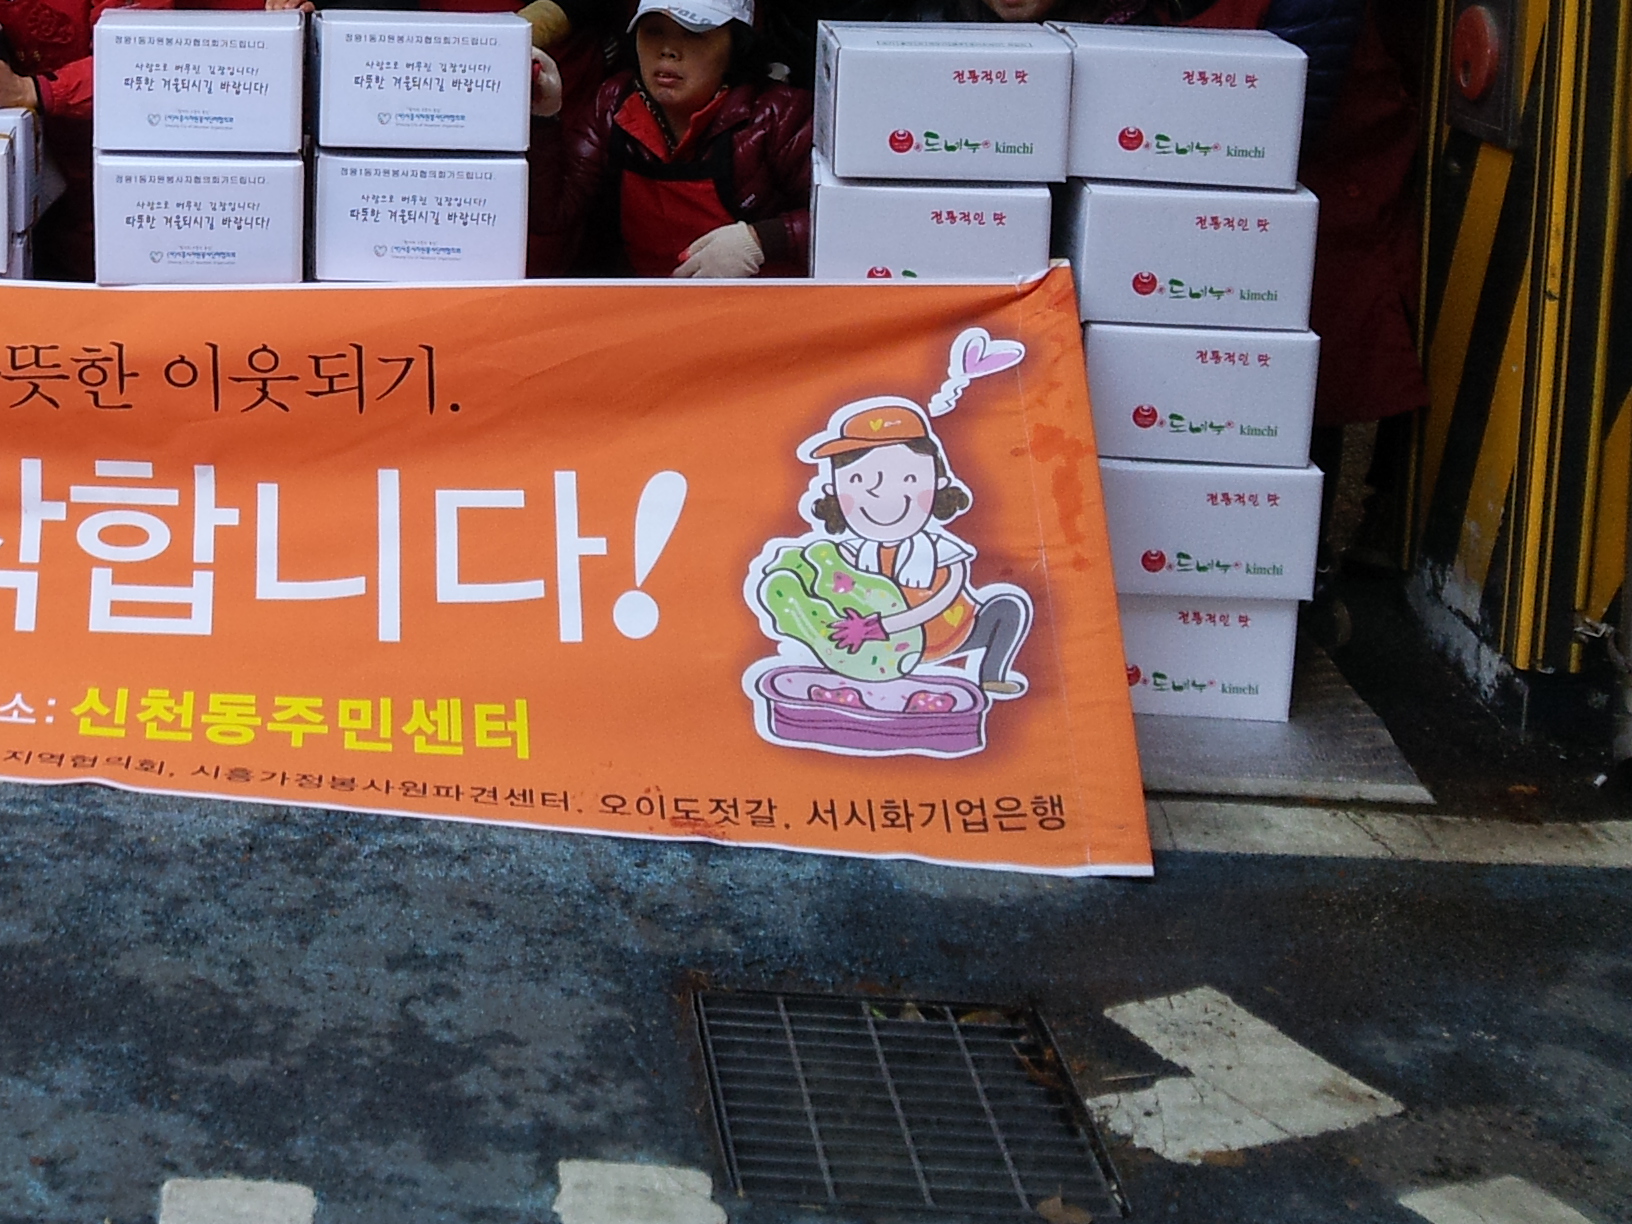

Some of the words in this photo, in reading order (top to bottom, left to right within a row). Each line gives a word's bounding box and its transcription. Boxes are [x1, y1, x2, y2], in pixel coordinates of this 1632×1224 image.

[124, 76, 156, 92] 따뜻한
[161, 77, 214, 95] 겨울되시길
[220, 81, 269, 96] 바랍니다!
[354, 74, 386, 90] 따뜻한
[391, 75, 445, 92] 겨울되시길
[451, 78, 501, 93] 바랍니다!
[953, 70, 1008, 85] 전통적인
[1015, 70, 1029, 84] 맛
[1183, 70, 1238, 88] 전통적인
[1246, 73, 1258, 89] 맛
[995, 141, 1034, 154] kimchi
[1226, 144, 1266, 159] kimchi
[125, 214, 157, 229] 따뜻한
[162, 214, 215, 230] 겨울되시길
[221, 216, 271, 230] 바랍니다!
[349, 207, 382, 223] 따뜻한
[387, 208, 441, 226] 겨울되시길
[447, 212, 497, 227] 바랍니다!
[930, 210, 986, 226] 전통적인
[993, 211, 1007, 227] 맛
[1195, 215, 1250, 231] 전통적인
[1257, 218, 1270, 233] 맛
[1239, 287, 1279, 302] kimchi
[1196, 349, 1250, 366] 전통적인
[1257, 354, 1272, 367] 맛
[164, 342, 461, 415] 이웃되기.
[1239, 423, 1279, 437] kimchi
[1206, 492, 1260, 507] 전통적인
[1266, 493, 1281, 507] 맛
[1245, 562, 1284, 576] kimchi
[1178, 610, 1230, 627] 전통적인
[1238, 613, 1252, 628] 맛
[1221, 681, 1260, 696] kimchi
[69, 686, 530, 759] 신천동주민센터
[806, 794, 1067, 834] 서시화기업은행
